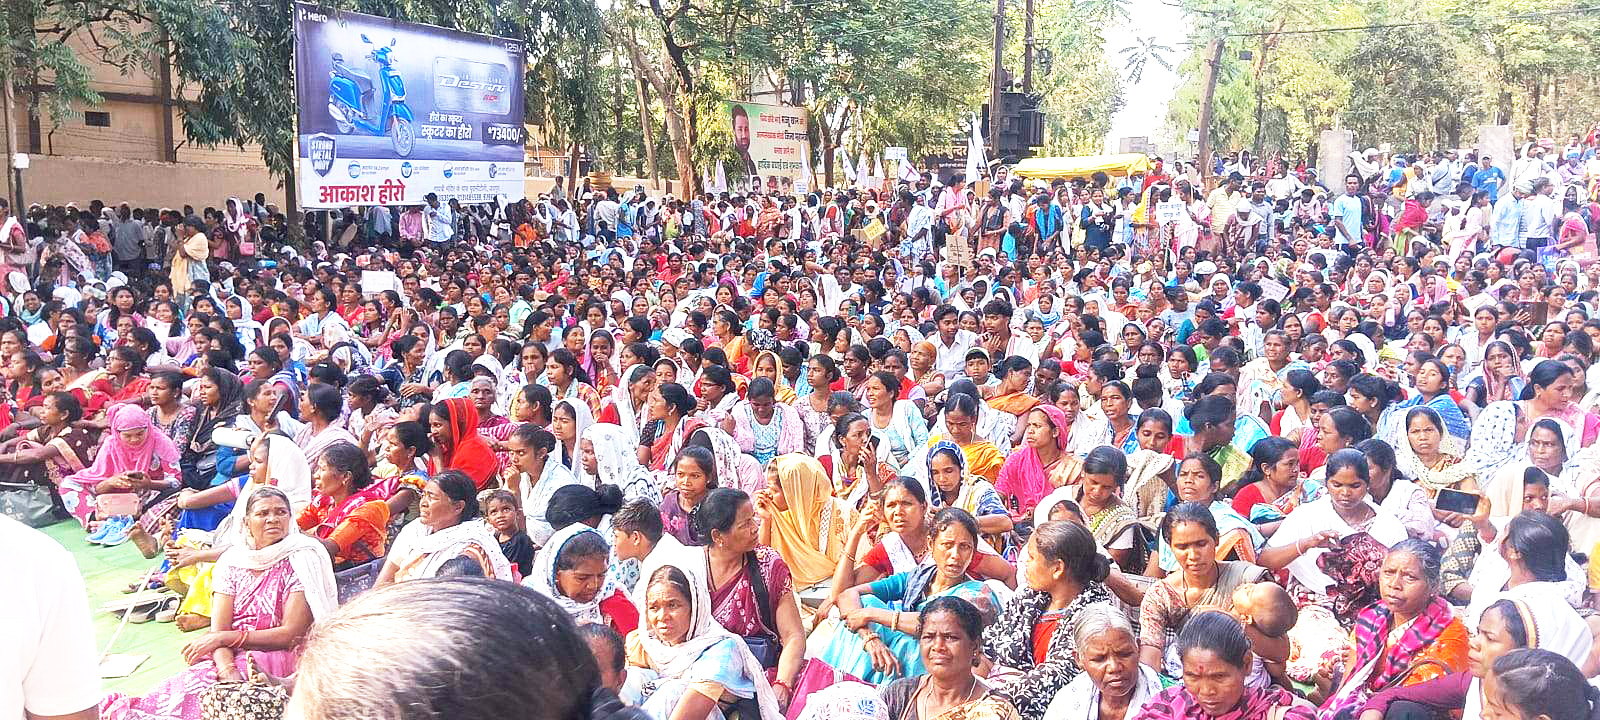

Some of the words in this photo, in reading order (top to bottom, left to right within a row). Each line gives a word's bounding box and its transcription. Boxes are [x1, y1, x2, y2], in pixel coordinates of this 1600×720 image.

[307, 11, 328, 23] Hero
[421, 125, 445, 140] स्कूटर
[445, 126, 457, 138] का
[457, 123, 473, 139] हीरो
[312, 149, 333, 160] METAL
[319, 185, 375, 203] आकाश
[378, 178, 406, 204] हीरो
